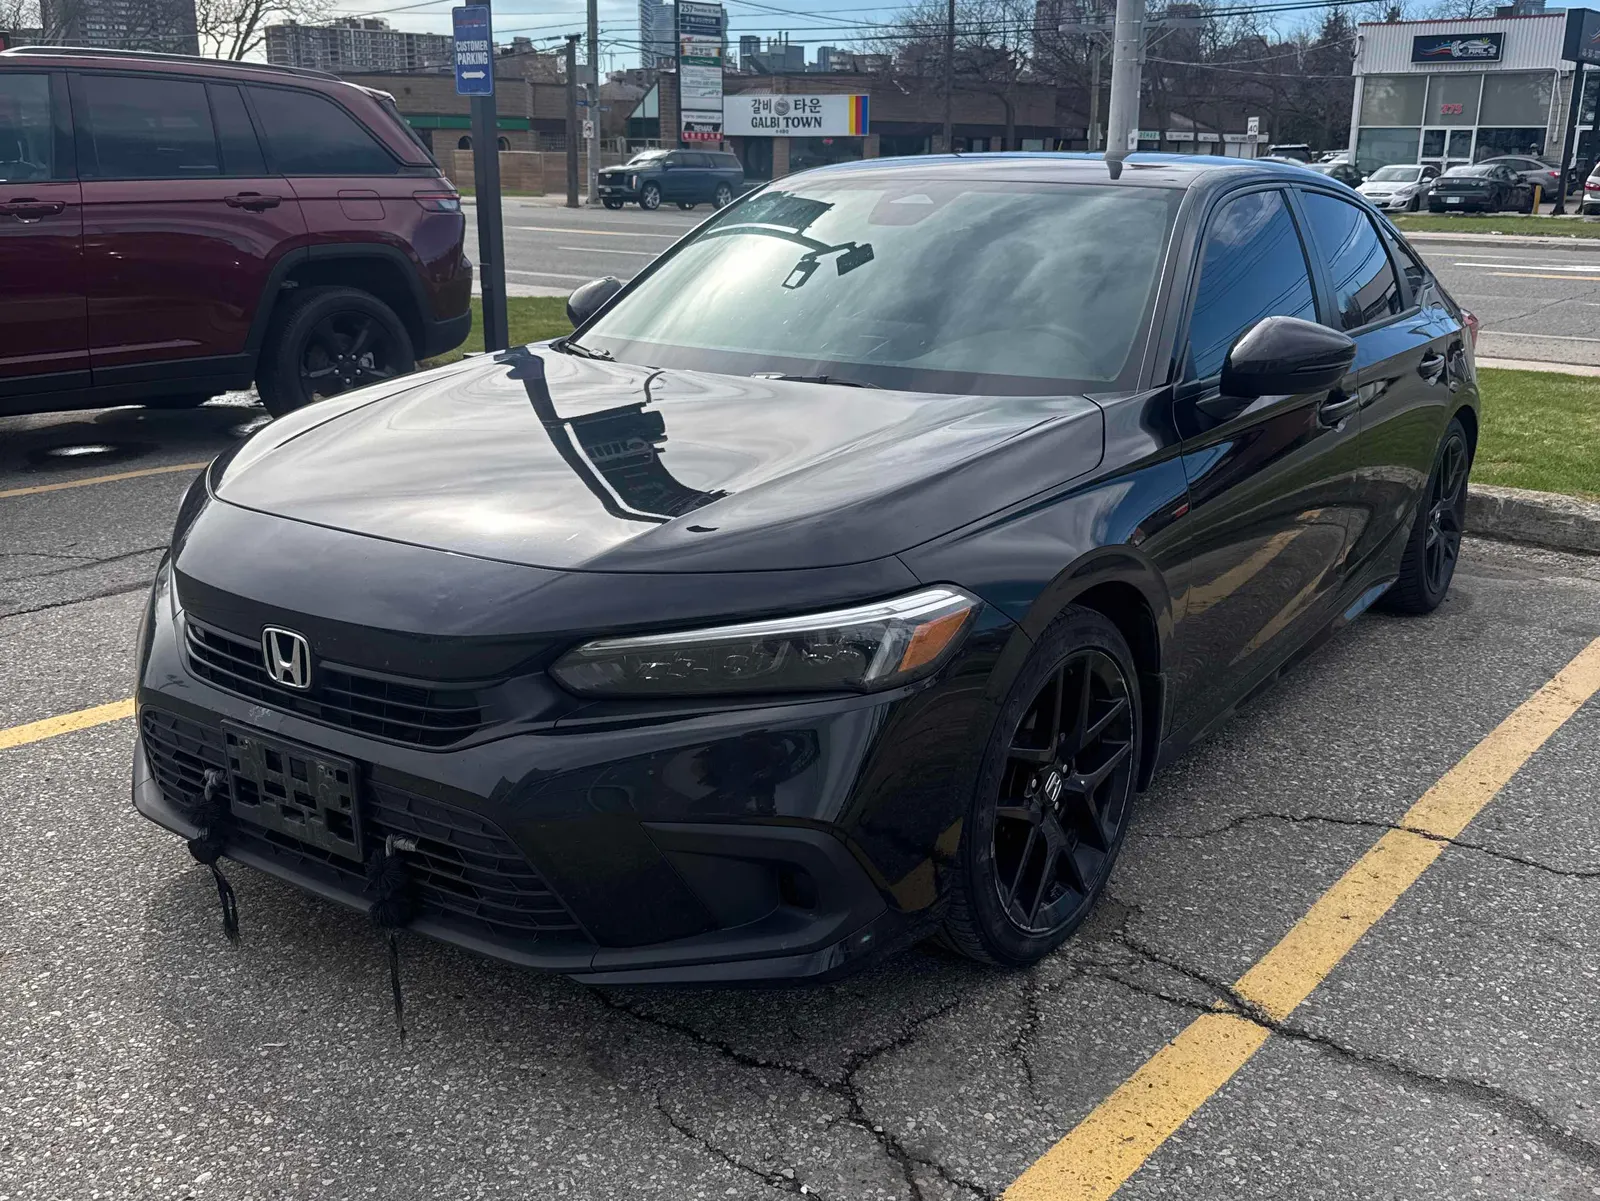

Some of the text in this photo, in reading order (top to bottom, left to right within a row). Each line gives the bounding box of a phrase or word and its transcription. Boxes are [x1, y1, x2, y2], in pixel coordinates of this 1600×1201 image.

[681, 4, 693, 13] 257
[455, 40, 489, 52] CUSTOMER
[457, 51, 489, 66] PARKING
[751, 97, 822, 115] 갈비 타운
[1440, 103, 1463, 115] 275
[751, 116, 823, 129] GALBI TOWN
[1248, 124, 1258, 133] 40
